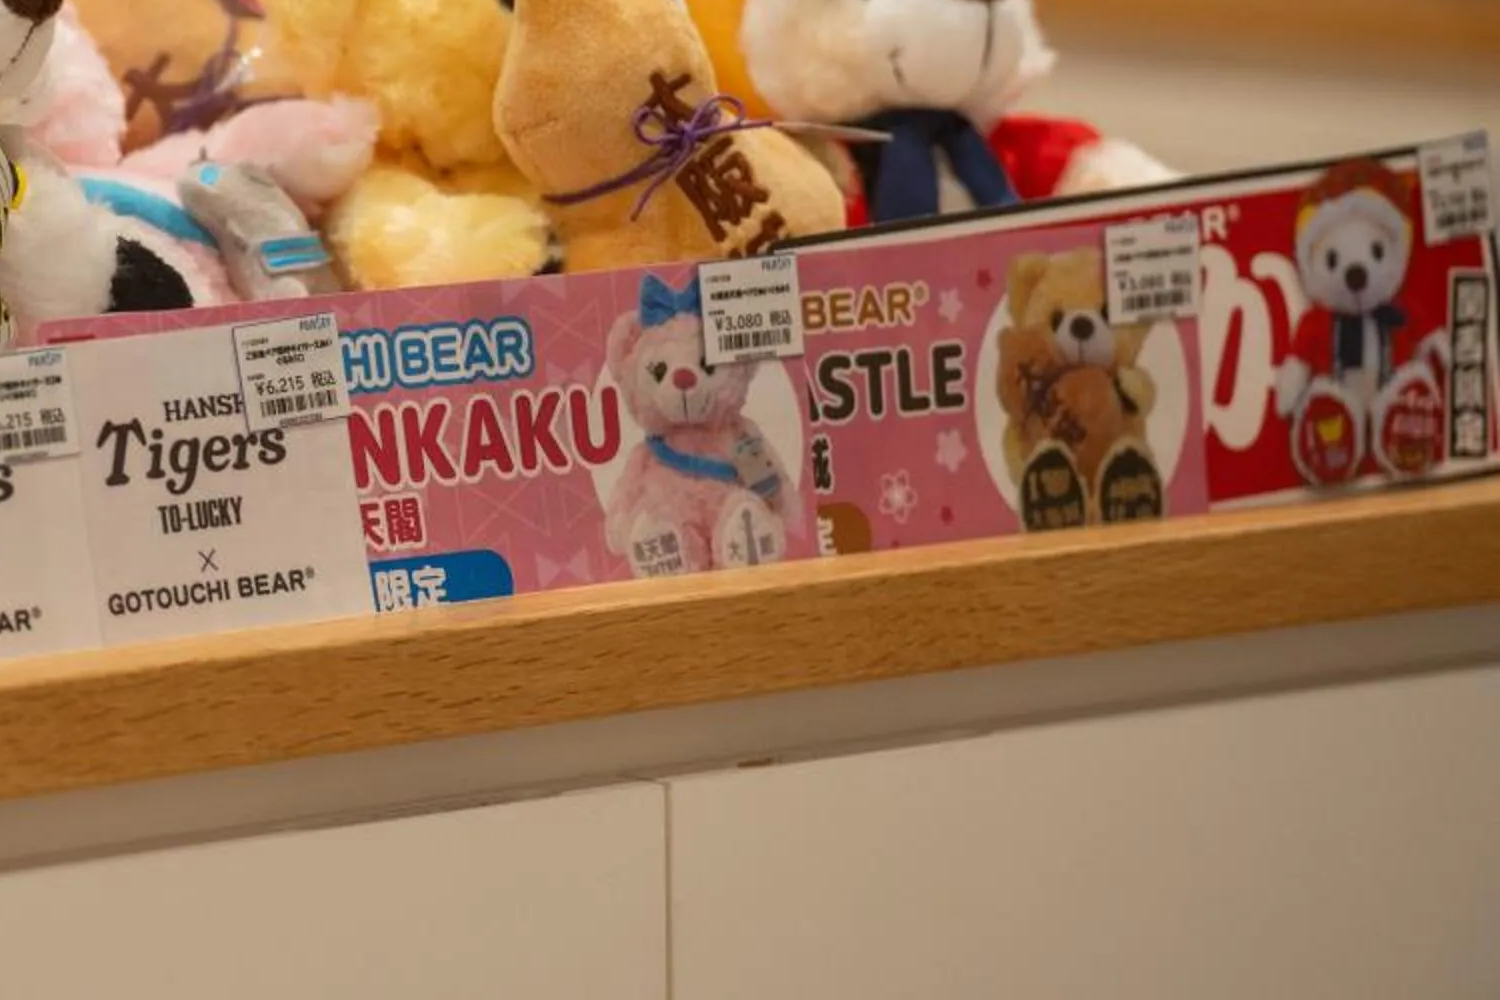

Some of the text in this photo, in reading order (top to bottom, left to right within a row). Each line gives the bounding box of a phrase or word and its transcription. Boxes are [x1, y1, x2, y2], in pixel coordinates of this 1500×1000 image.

[397, 324, 531, 382] BEAR
[97, 417, 288, 496] Tigers
[348, 386, 621, 489] NKAKU
[157, 496, 243, 534] TO-LUCKY
[108, 579, 231, 616] GOTOUCHI
[374, 565, 448, 612] 限定
